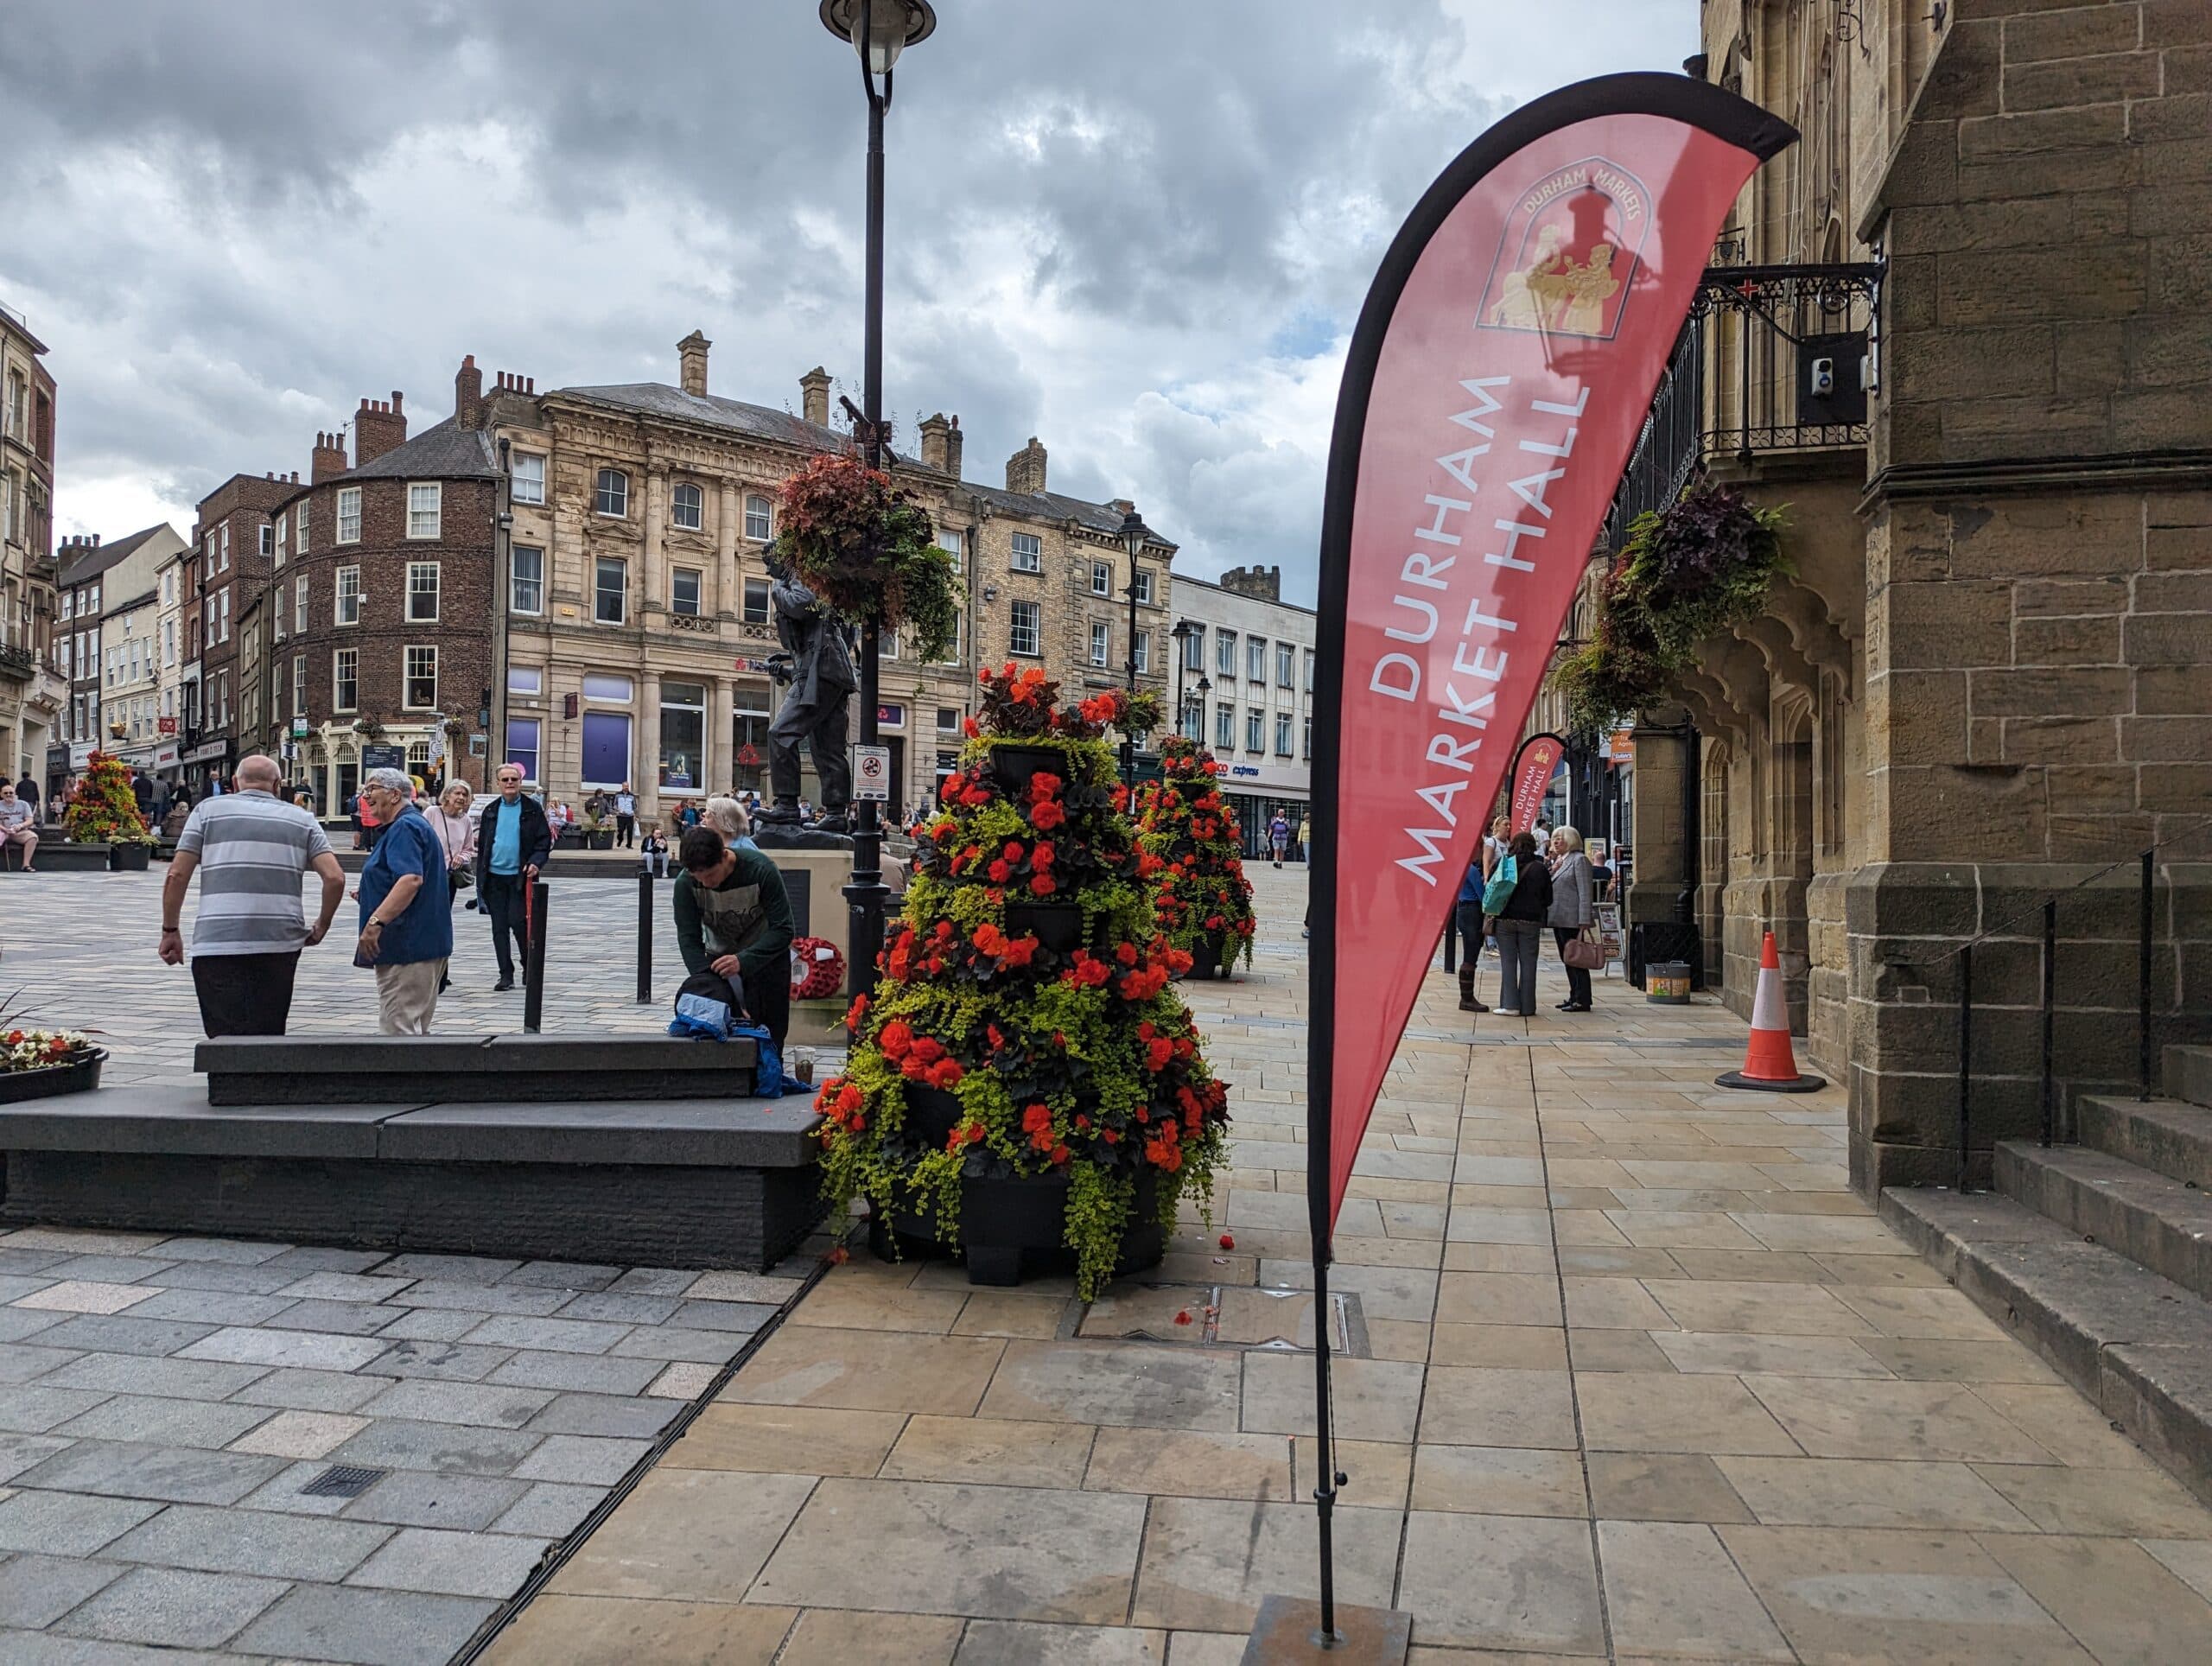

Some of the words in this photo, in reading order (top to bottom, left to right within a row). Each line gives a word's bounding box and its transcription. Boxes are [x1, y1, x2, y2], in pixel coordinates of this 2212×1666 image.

[1524, 168, 1586, 214] DURHAM
[1594, 168, 1641, 221] MARKETS
[1370, 375, 1510, 702] DURHAM
[1395, 599, 1518, 887] MARKET
[1484, 387, 1591, 572] HALL
[1233, 766, 1259, 777] express
[1515, 766, 1536, 810] DURHAM
[1532, 769, 1546, 794] HALL
